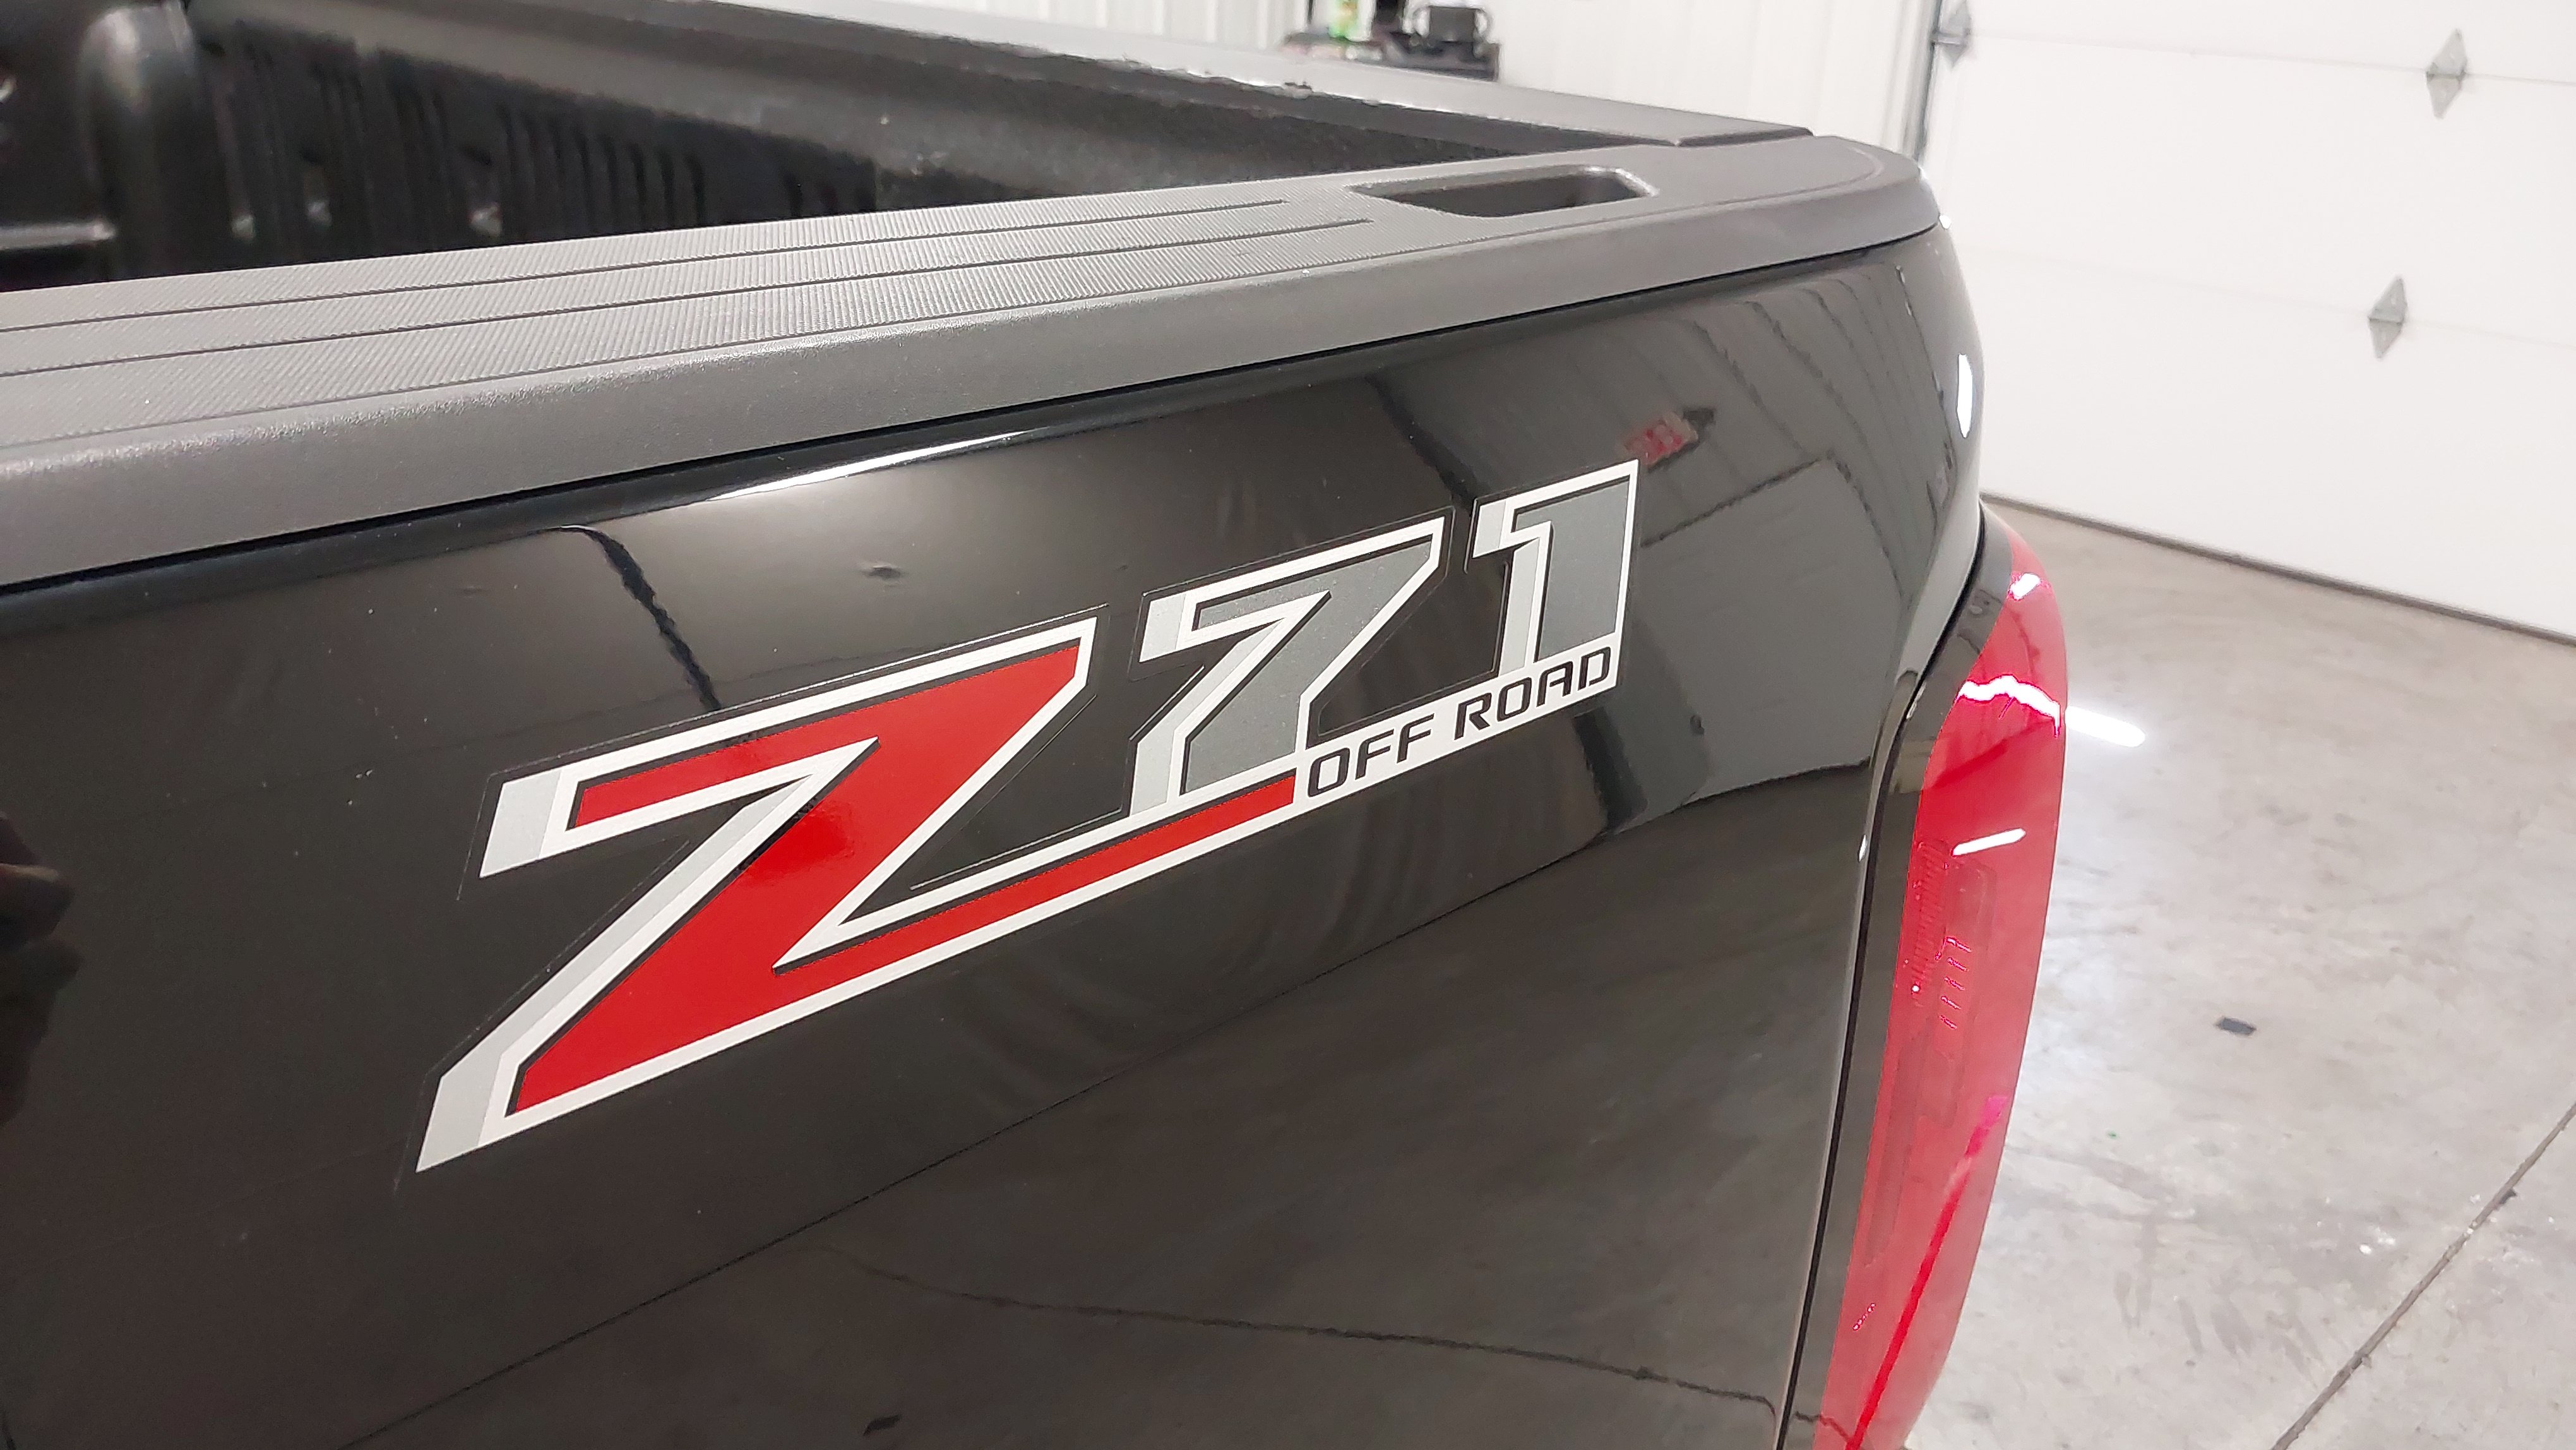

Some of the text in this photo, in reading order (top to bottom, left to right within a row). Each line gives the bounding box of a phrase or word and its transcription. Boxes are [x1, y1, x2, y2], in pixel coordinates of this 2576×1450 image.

[416, 459, 1640, 1173] Z71
[1307, 646, 1611, 798] OFF ROAD
